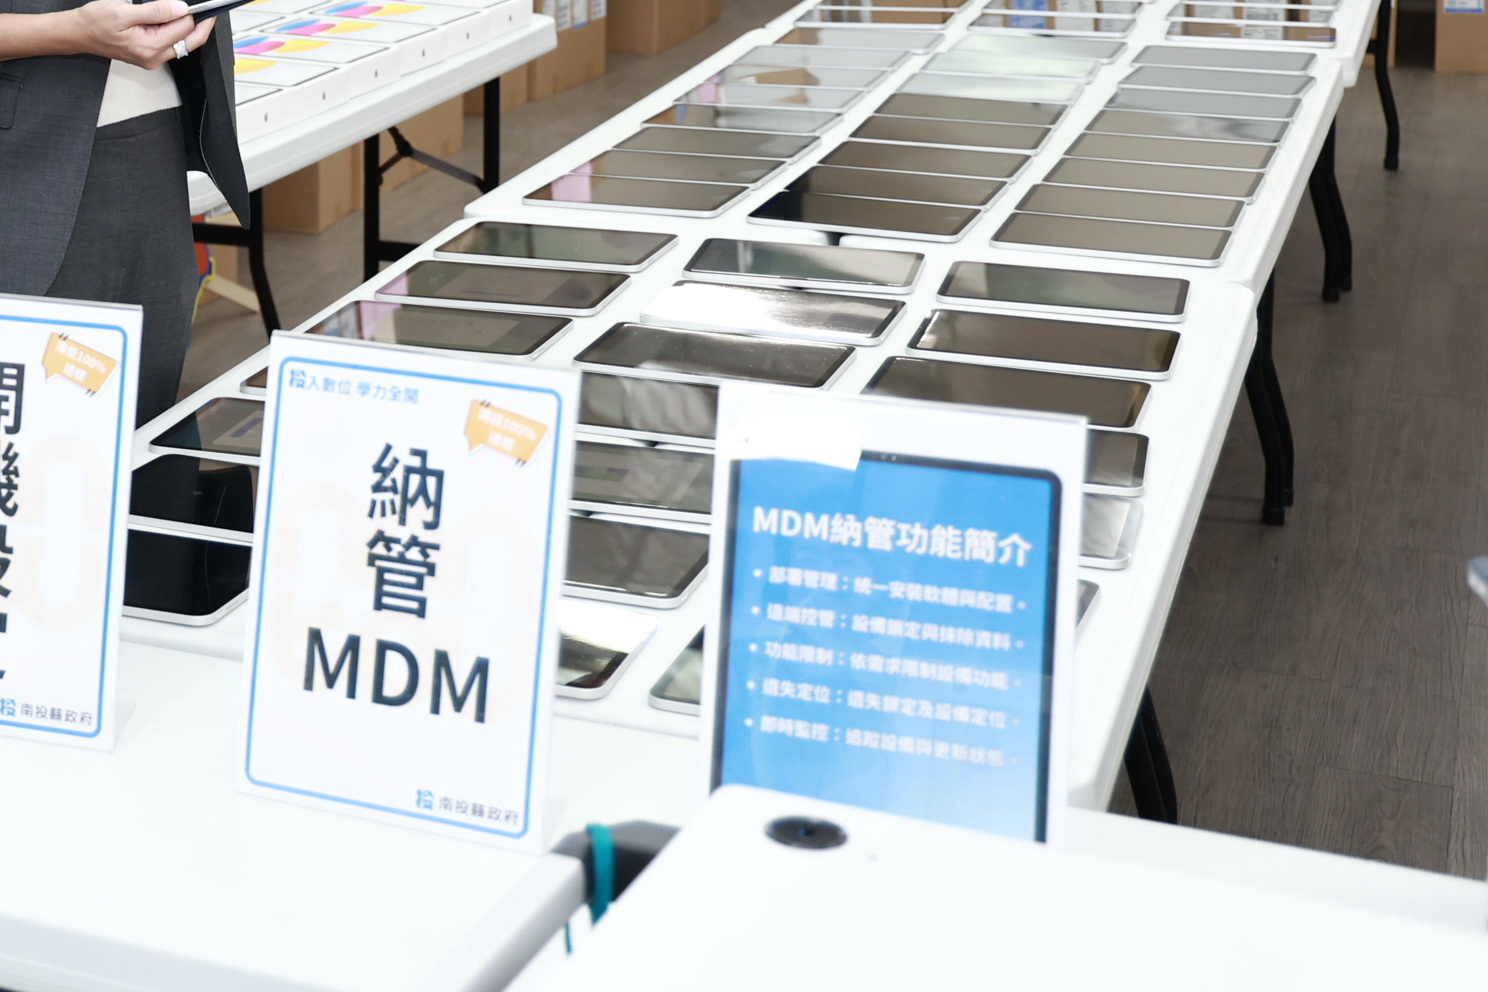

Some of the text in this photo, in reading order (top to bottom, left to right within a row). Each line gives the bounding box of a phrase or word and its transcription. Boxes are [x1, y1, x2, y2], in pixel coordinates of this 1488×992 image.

[365, 442, 445, 620] 納管
[752, 505, 1033, 568] MDM納管功能簡介
[302, 626, 491, 725] MDM
[20, 703, 93, 726] 南投縣政府
[438, 796, 519, 826] 南投縣政府
